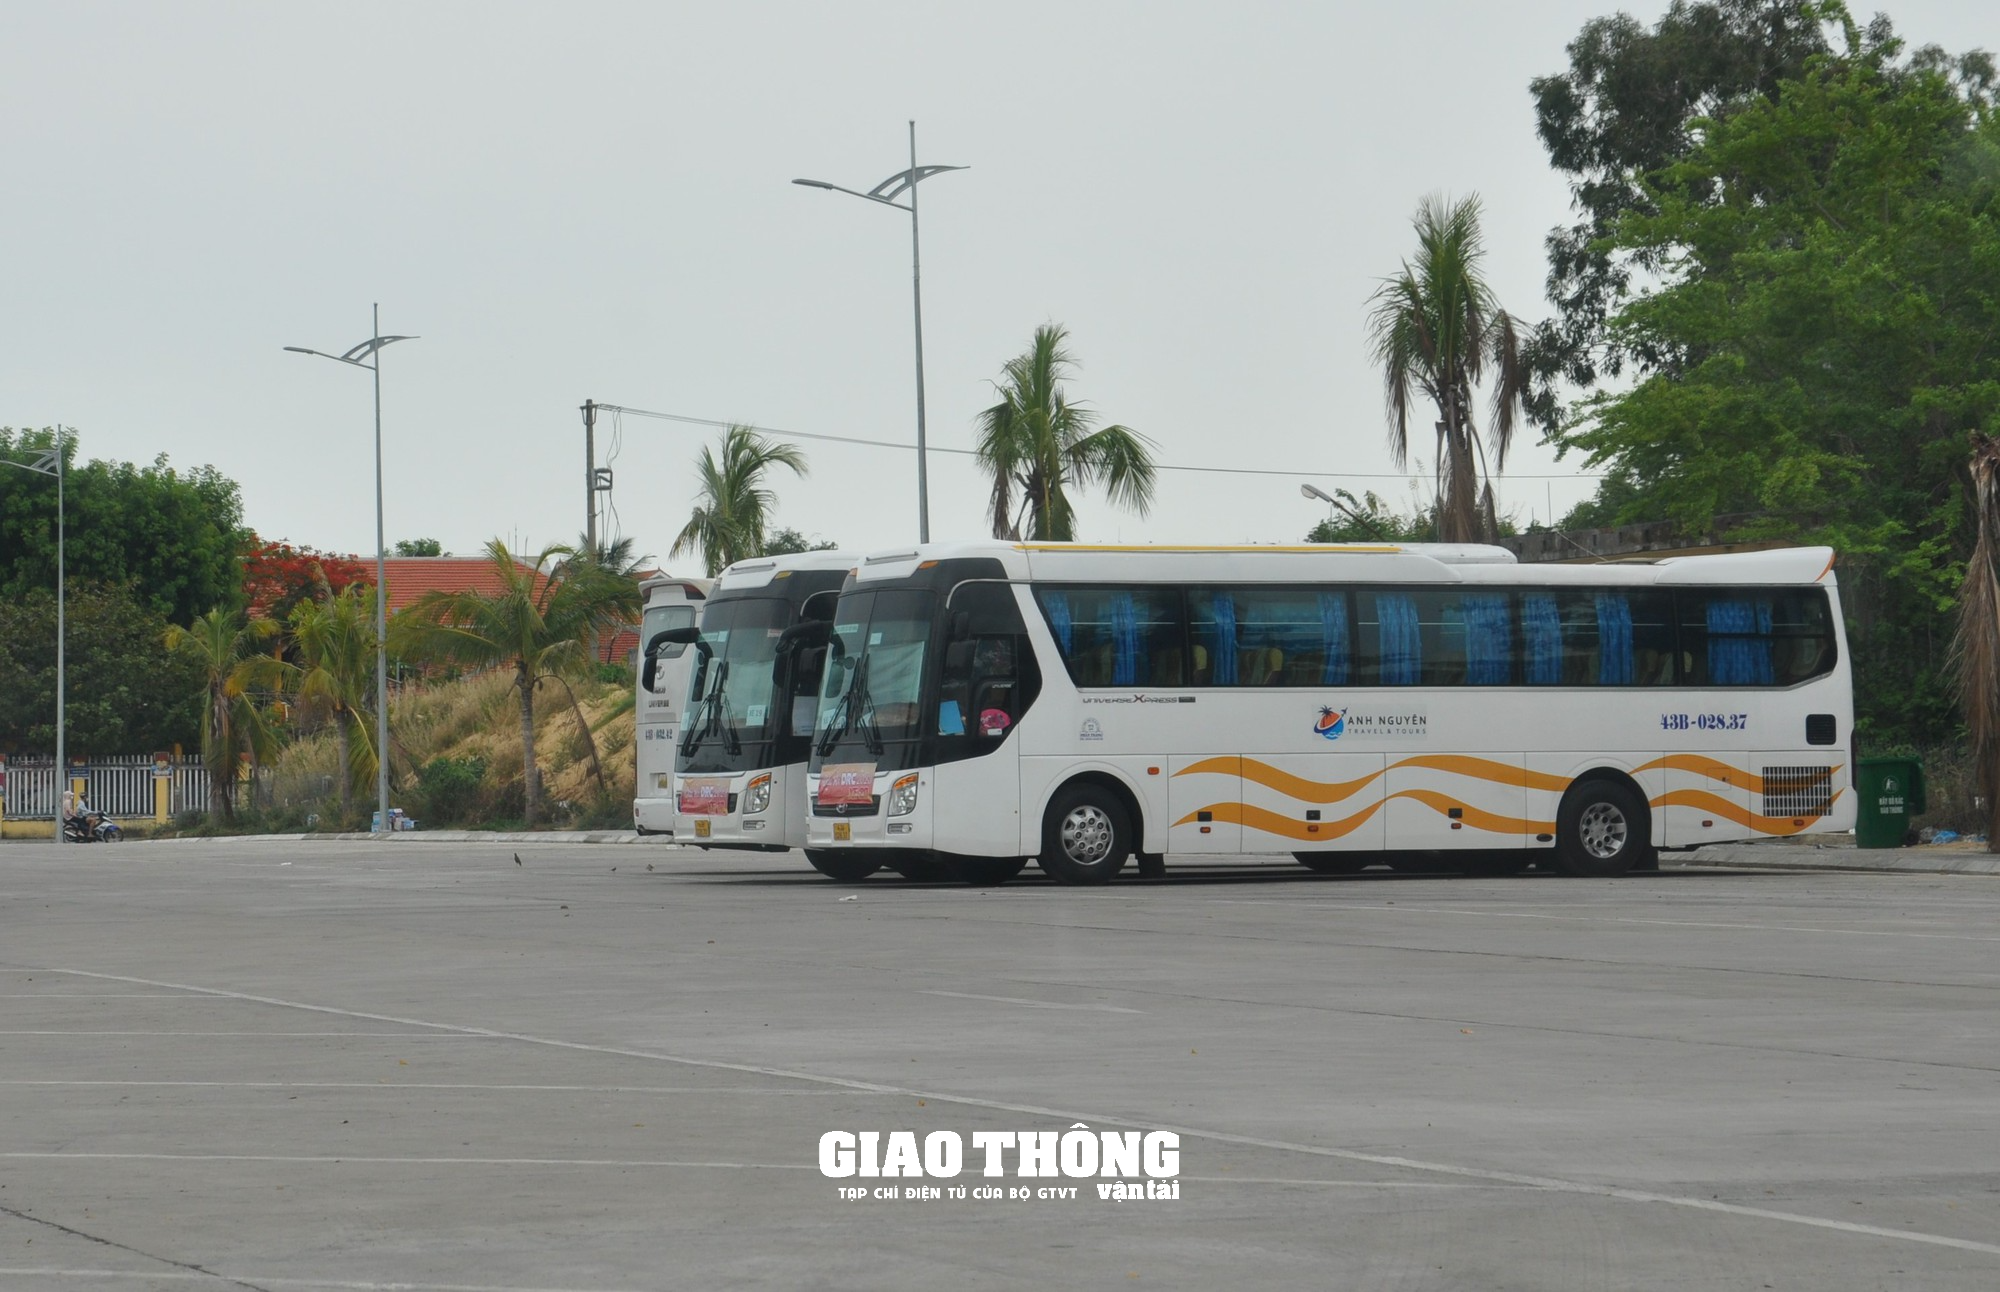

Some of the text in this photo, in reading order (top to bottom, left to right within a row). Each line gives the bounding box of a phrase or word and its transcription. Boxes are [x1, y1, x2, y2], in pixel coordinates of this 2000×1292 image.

[1347, 713, 1427, 726] ANH NGUYÊN
[1660, 713, 1748, 730] 43B-028.37
